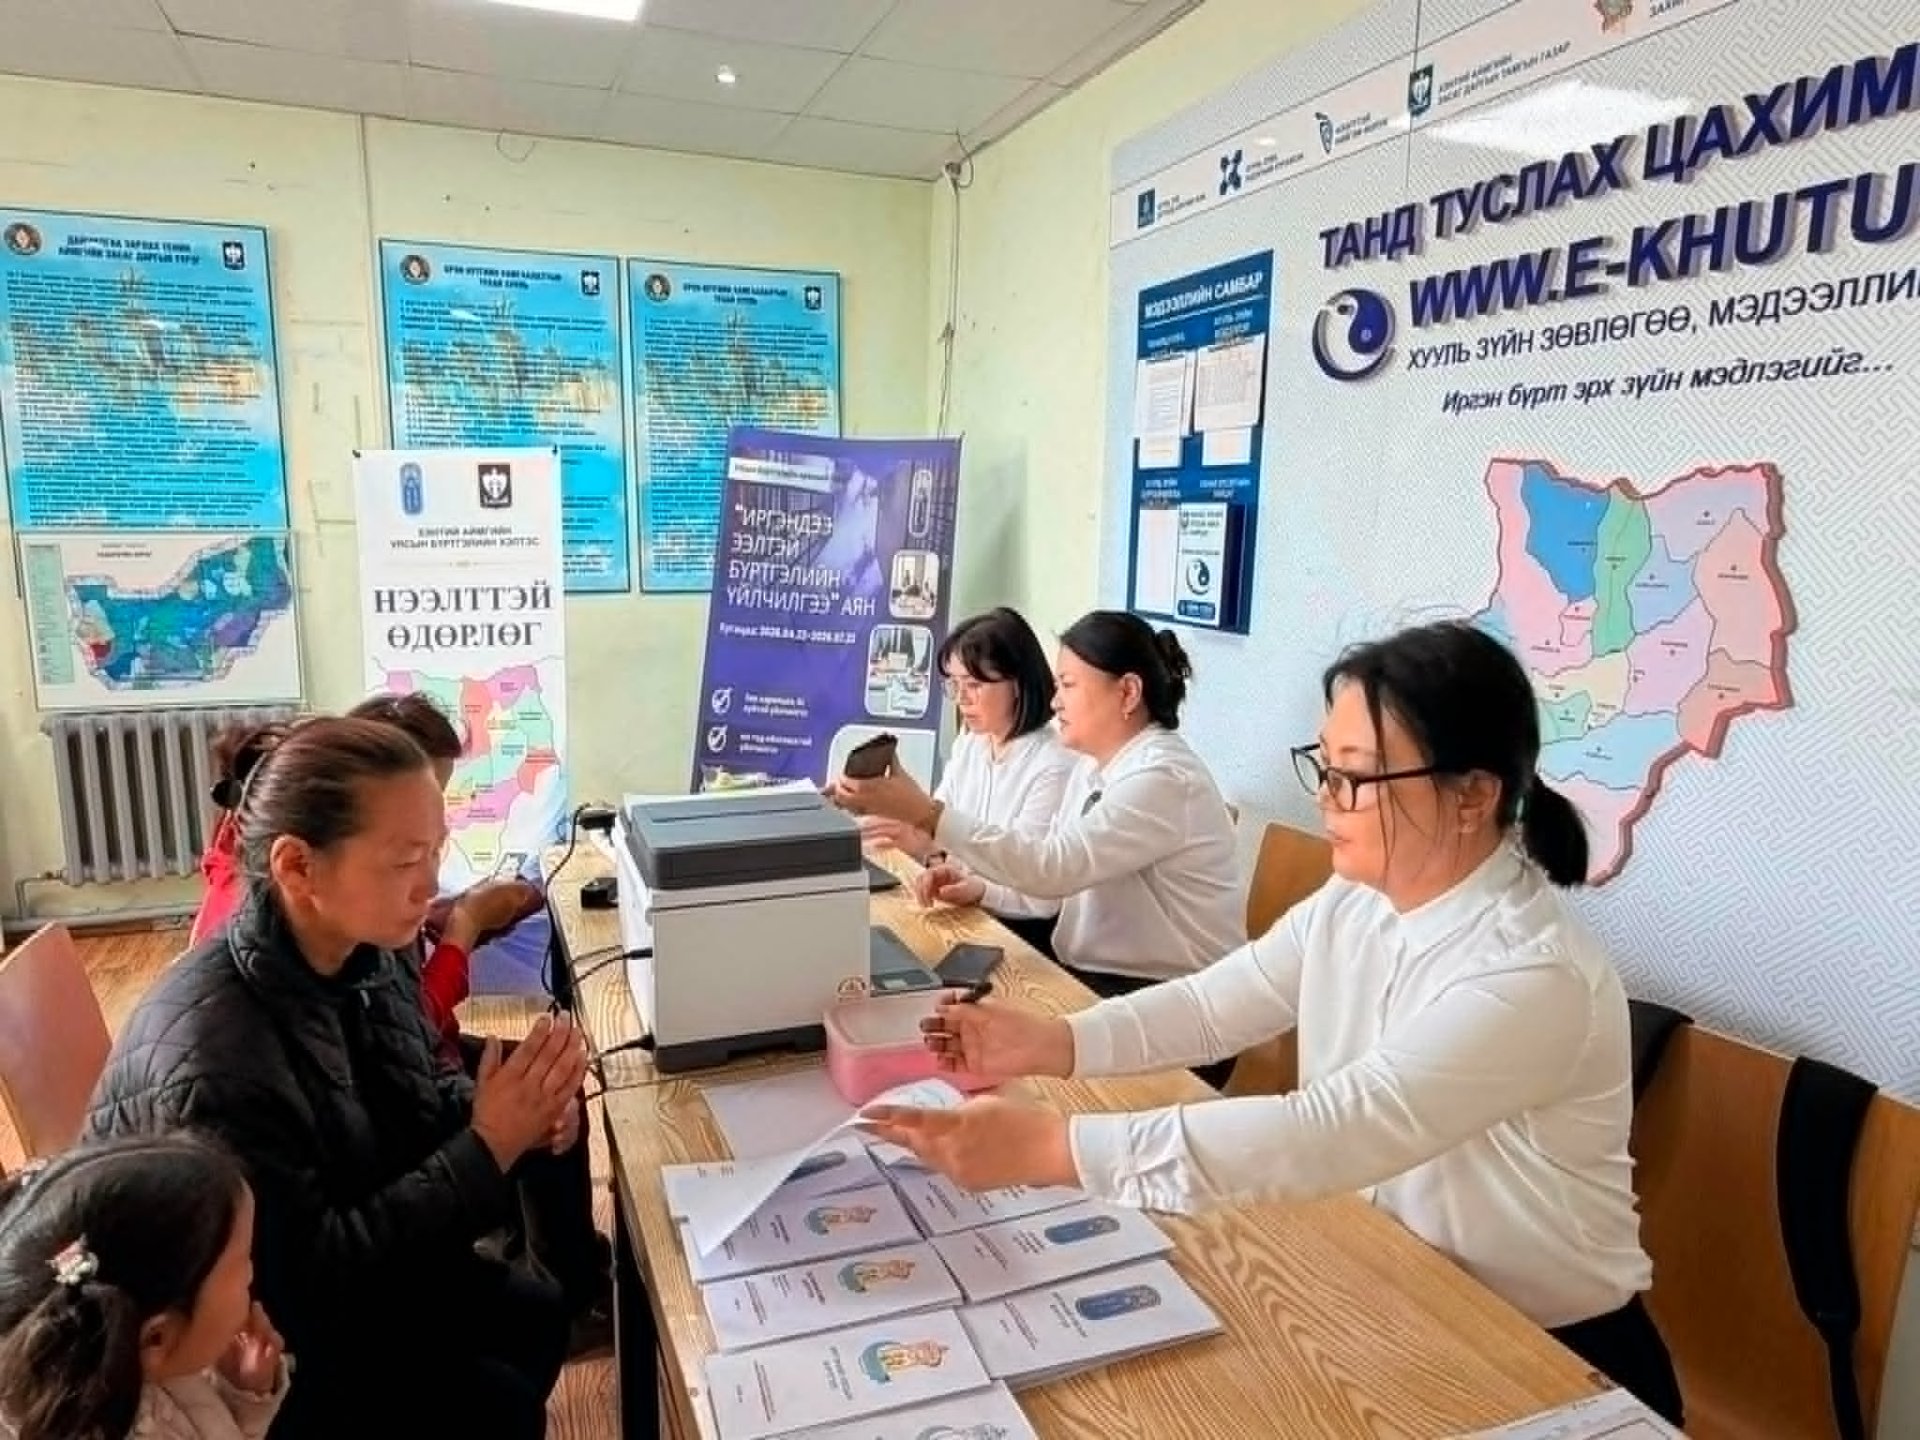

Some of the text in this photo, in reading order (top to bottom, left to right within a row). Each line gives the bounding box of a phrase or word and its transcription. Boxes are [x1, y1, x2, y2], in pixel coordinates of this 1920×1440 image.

[1320, 43, 1920, 268] ТАНД ТУСЛАХ ЦАХИМ
[1214, 271, 1263, 300] САМБАР
[1408, 342, 1471, 371] ХУУЛЬ
[1476, 327, 1535, 361] ЗҮЙН
[1540, 305, 1697, 351] ЗӨВЛӨГӨӨ,
[1442, 347, 1894, 415] Иргэн бүрт эрх зүйн мэдлэгийг...
[390, 536, 541, 549] УЛСЫН БҮРТГЭЛИЙН ХЭЛТЭС
[462, 525, 512, 537] АЙМГИЙН
[729, 559, 841, 588] БҮРТГЭЛИЙН
[375, 578, 552, 614] НЭЭЛТТЭЙ
[840, 597, 876, 616] АЯН
[387, 621, 542, 653] ӨДӨРЛӨГ
